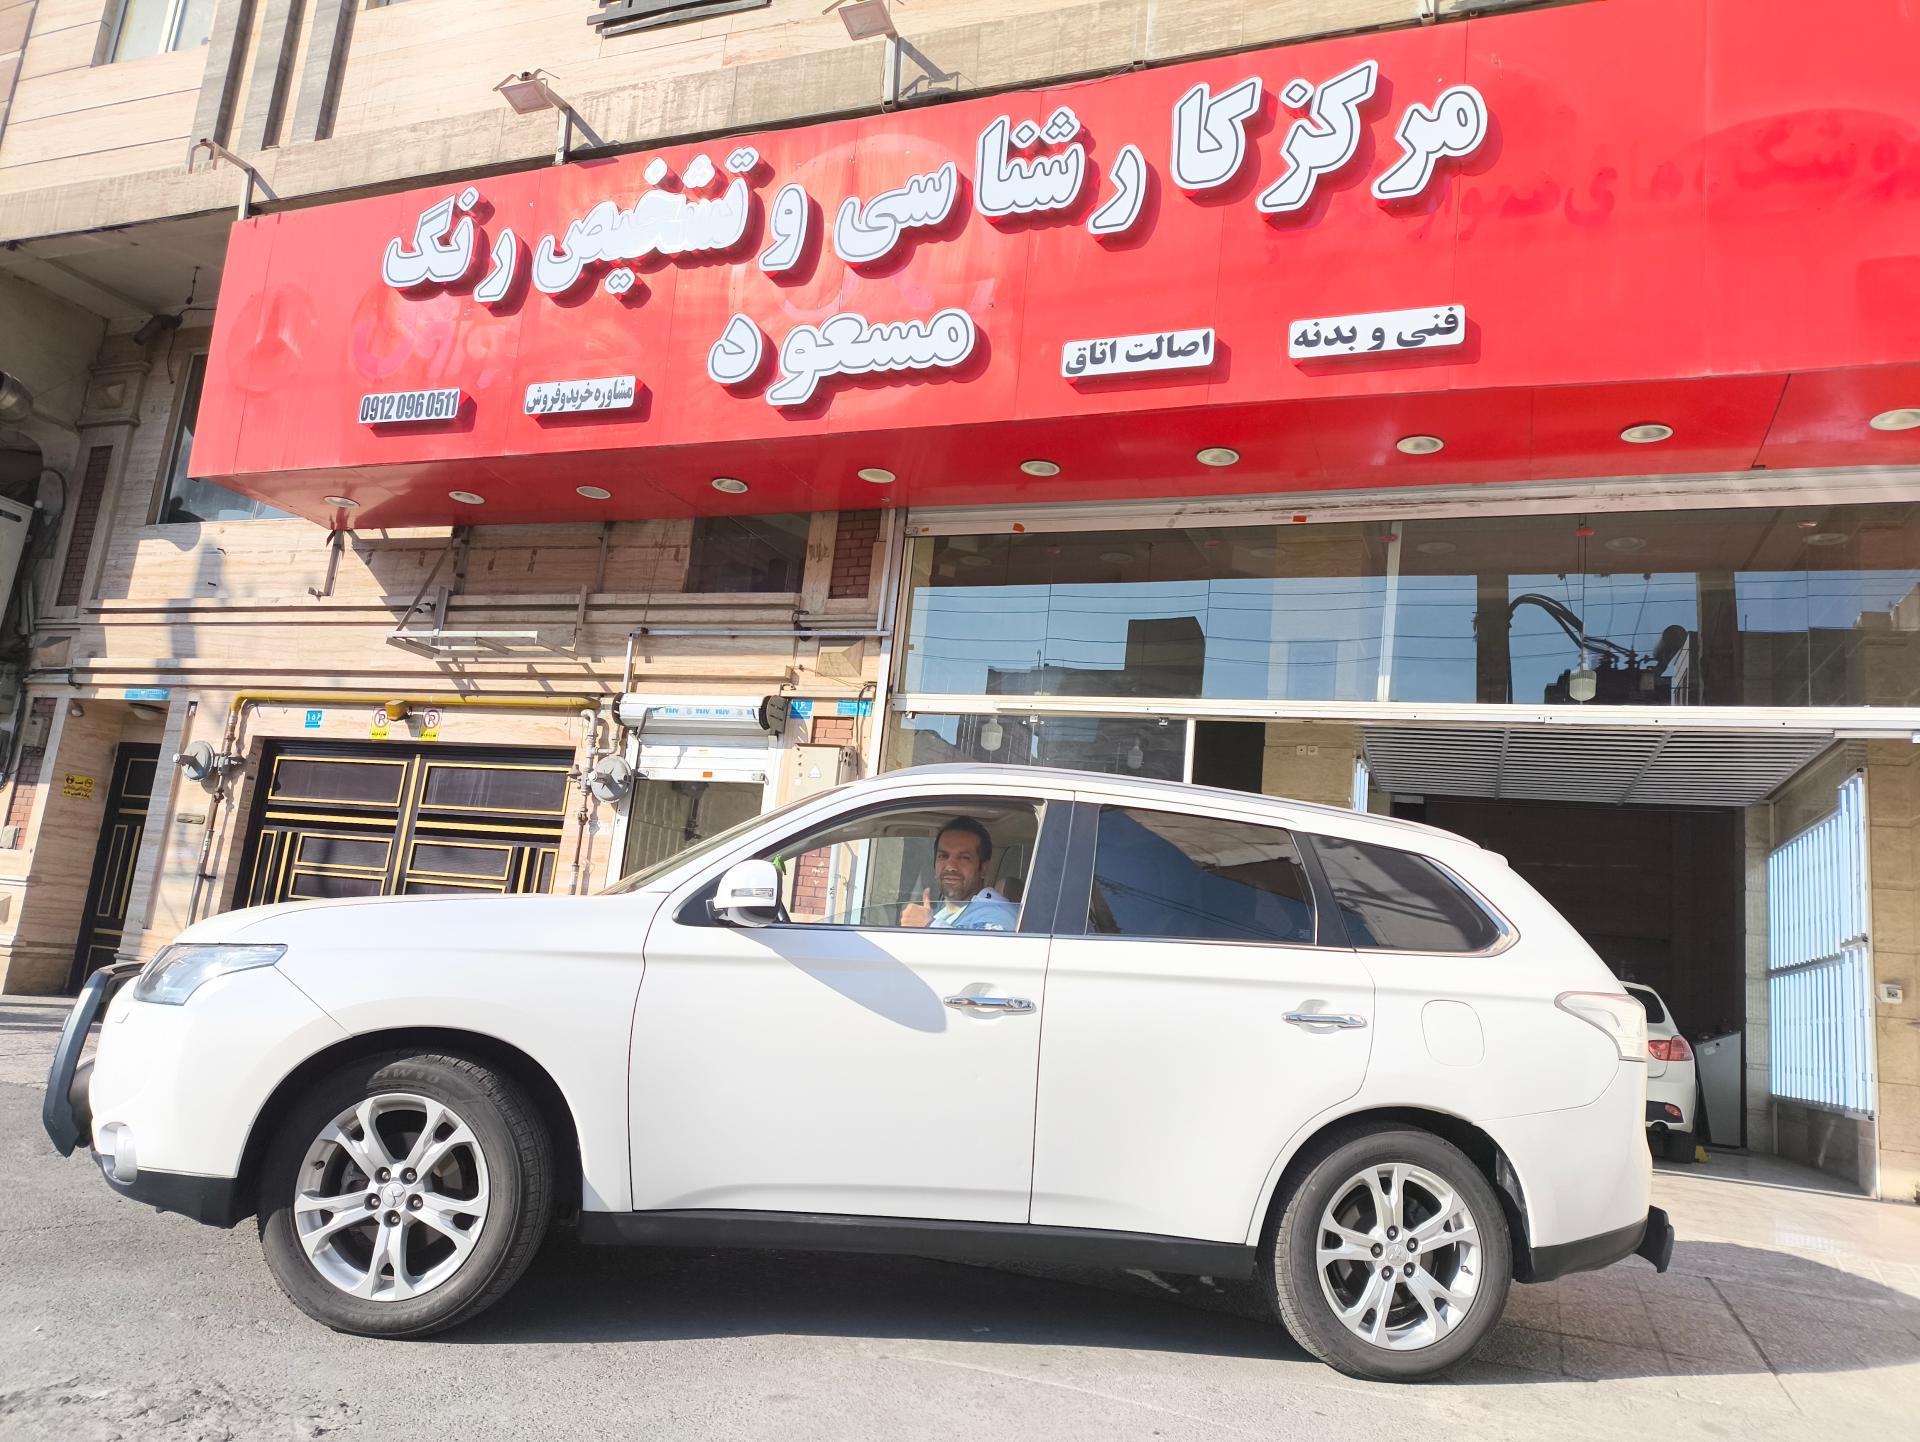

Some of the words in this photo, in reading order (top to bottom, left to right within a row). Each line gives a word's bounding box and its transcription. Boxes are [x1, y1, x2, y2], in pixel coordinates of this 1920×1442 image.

[1257, 60, 1487, 213] مرکز
[834, 76, 1263, 263] کارشناسی
[532, 146, 760, 294] تشخیص
[758, 183, 809, 271] و
[383, 186, 517, 302] رنگ
[1124, 331, 1211, 363] اصالت
[1293, 322, 1358, 352] بدنه
[1367, 328, 1387, 350] و
[1397, 306, 1460, 347] فنی
[707, 308, 975, 406] مسعود
[1065, 340, 1117, 375] اتاق
[360, 395, 395, 422] 0912
[395, 393, 424, 420] 096
[425, 390, 459, 420] 0511
[594, 379, 633, 408] مشاوره
